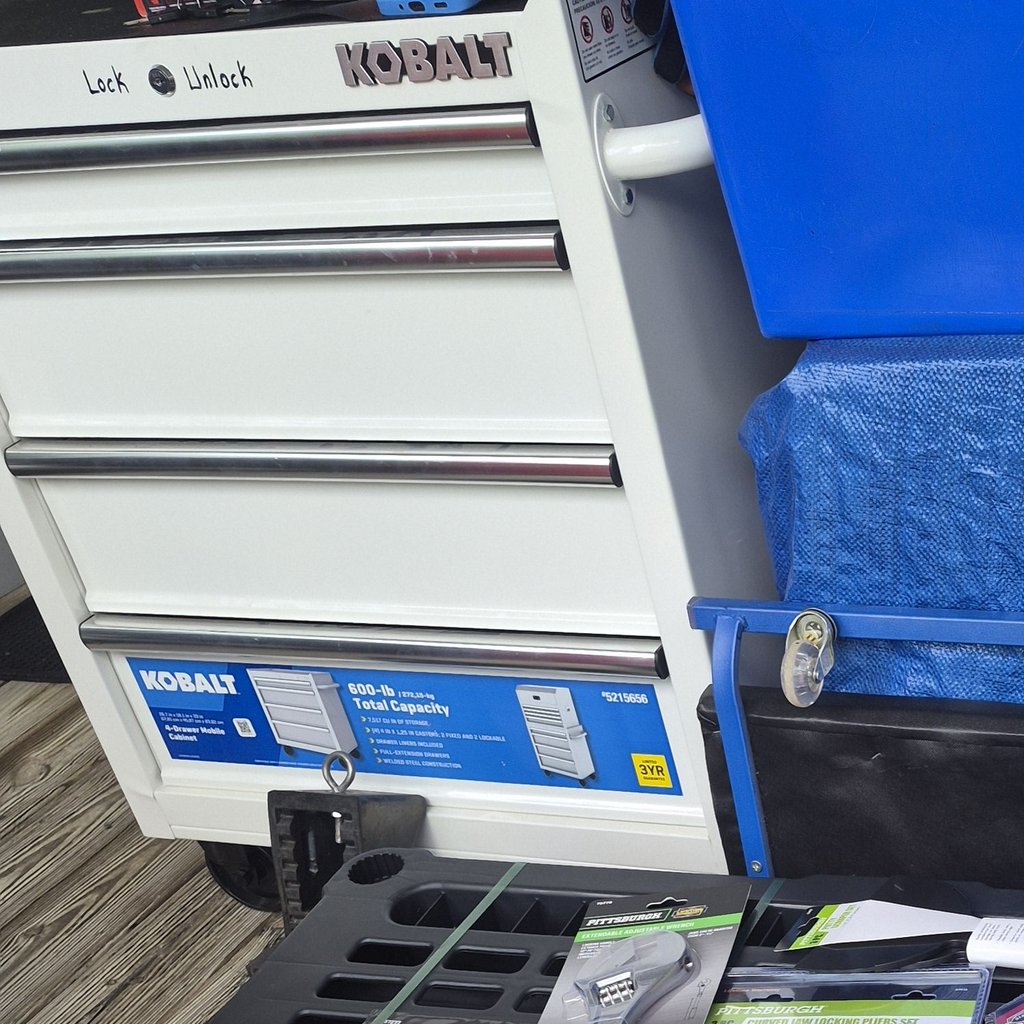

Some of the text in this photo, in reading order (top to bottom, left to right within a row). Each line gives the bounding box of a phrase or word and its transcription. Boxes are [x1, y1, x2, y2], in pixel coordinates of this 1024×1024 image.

[335, 31, 513, 88] KOBALT
[82, 60, 253, 96] Lock Unlock
[139, 670, 237, 695] KOBALT
[348, 683, 395, 697] 600-lb
[602, 691, 648, 703] #5215656
[353, 698, 449, 717] Total Capacity
[169, 733, 197, 741] Cabinet
[200, 727, 225, 735] Mobile
[639, 764, 665, 776] 3YR
[586, 912, 663, 927] PITTSBURGH
[667, 922, 695, 930] WRENCH
[714, 1004, 826, 1016] PITTSBURGH
